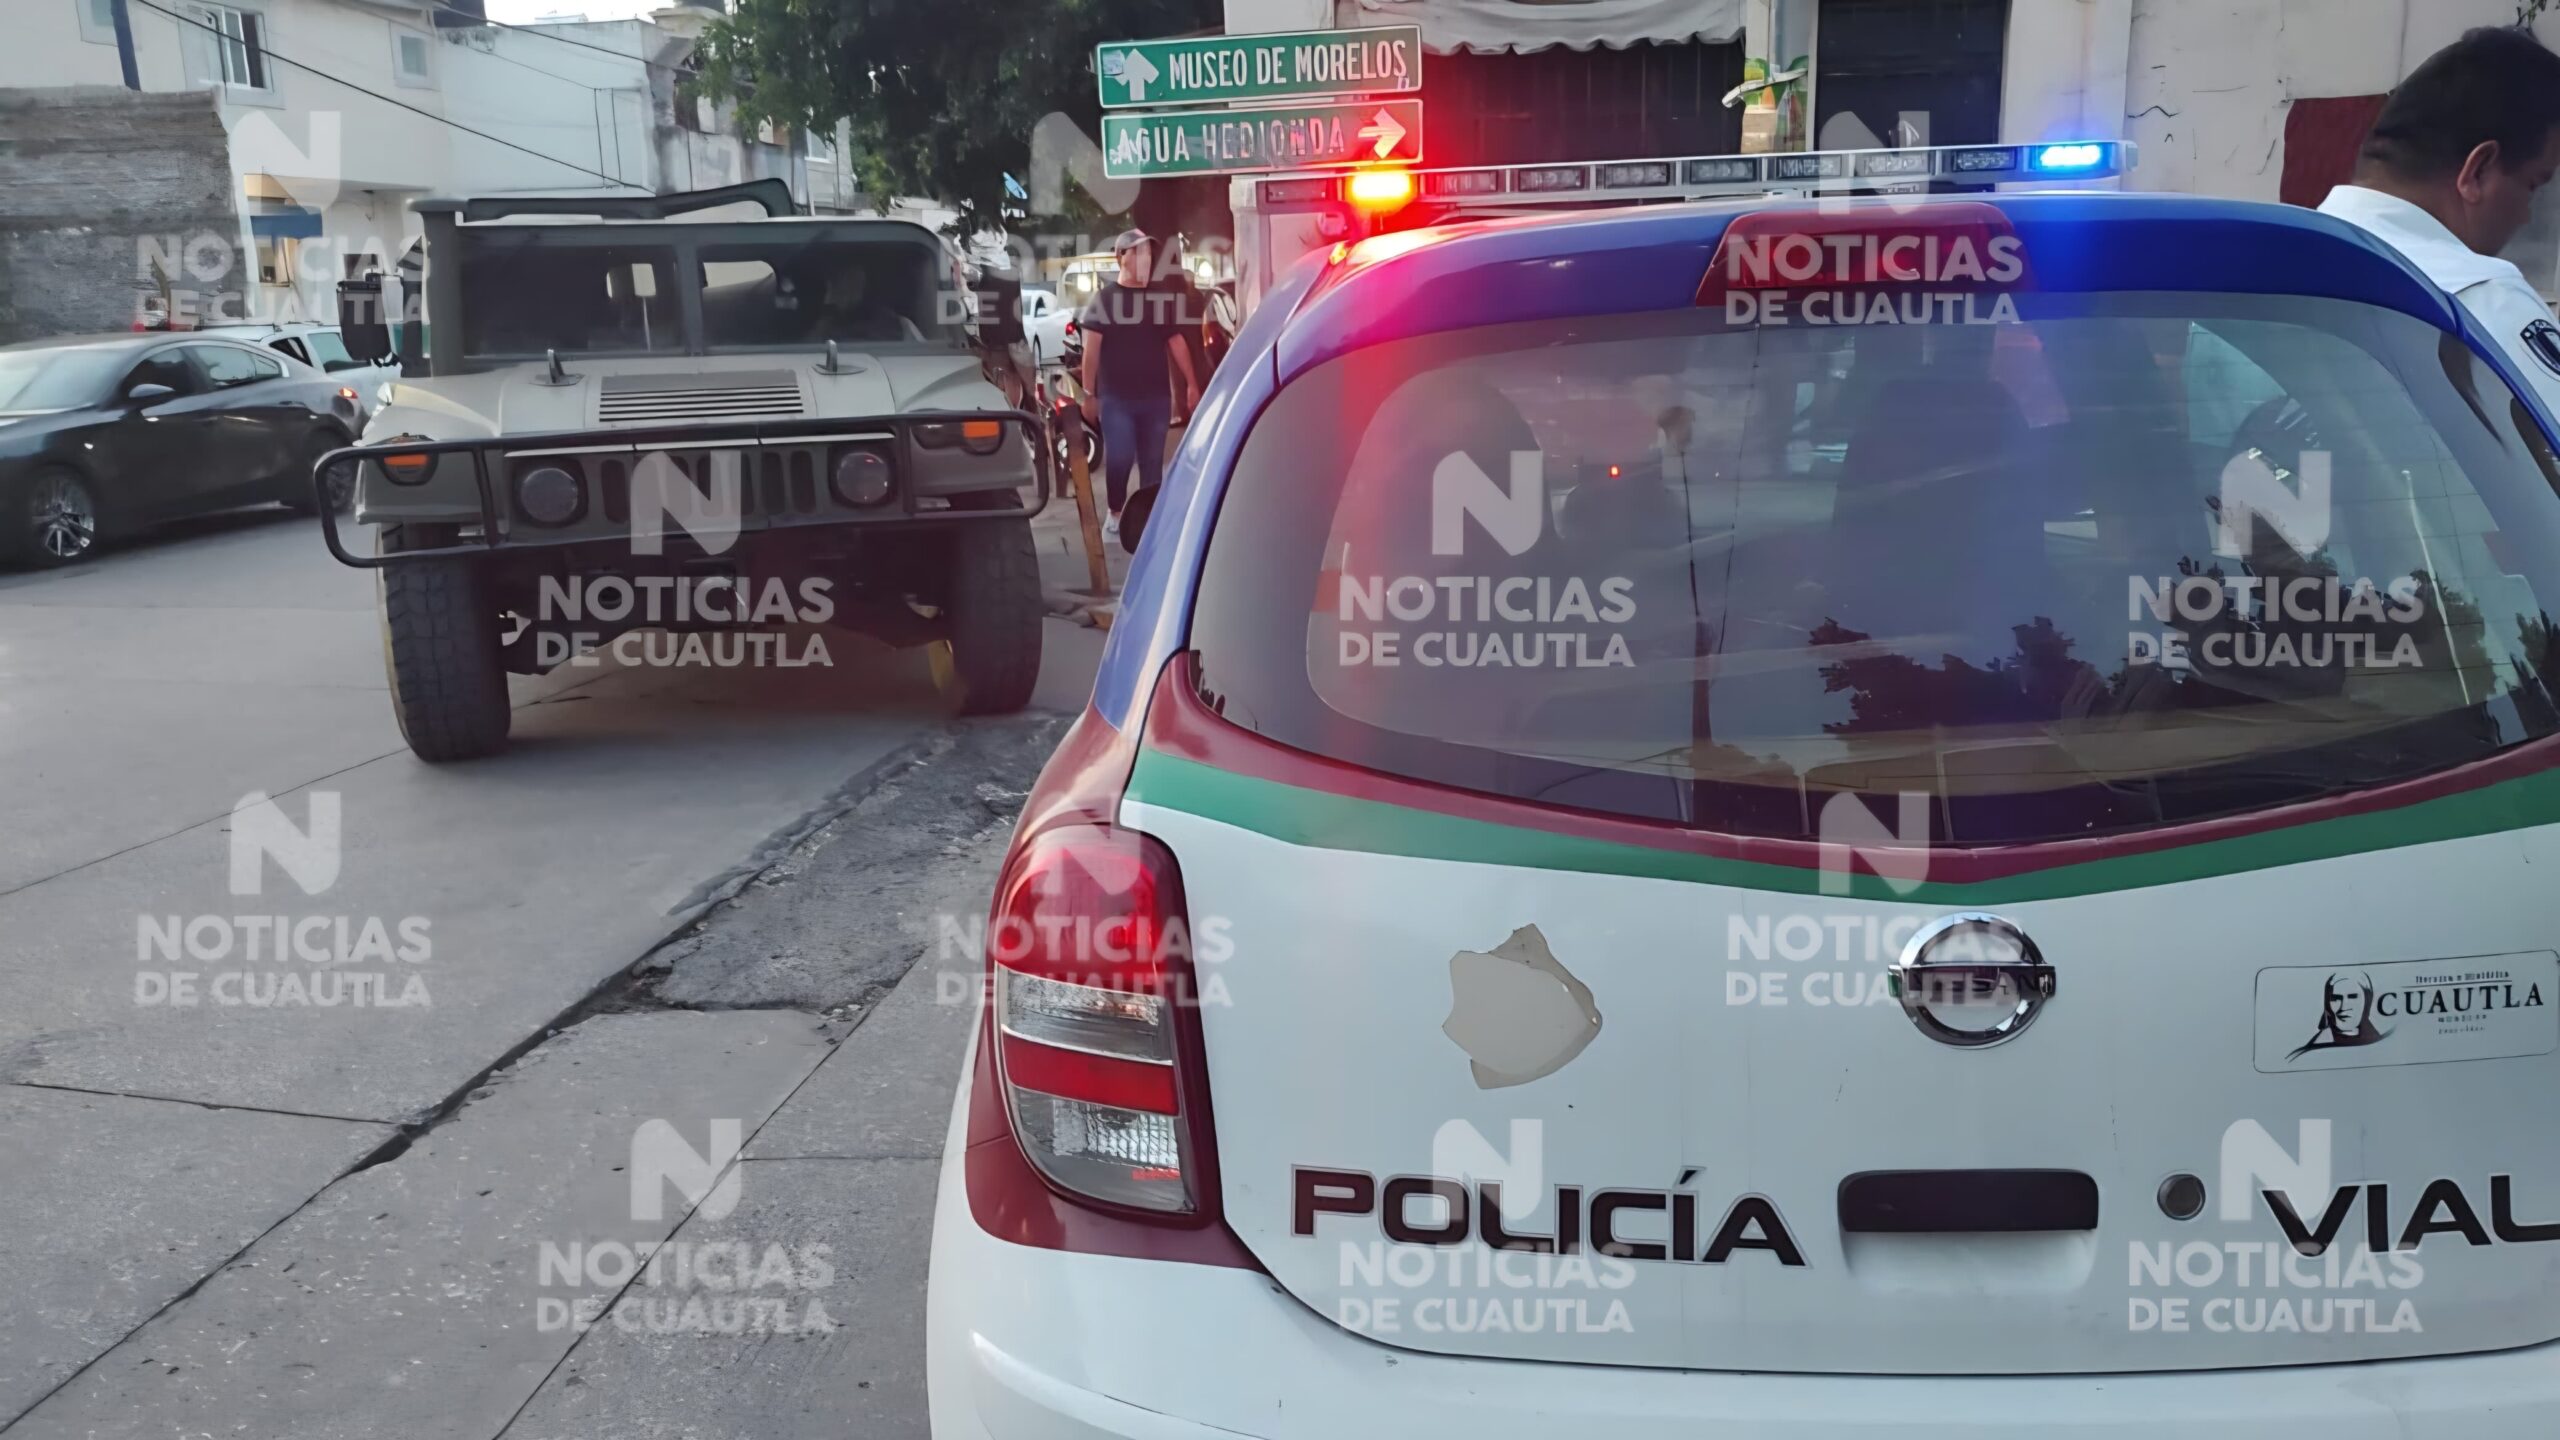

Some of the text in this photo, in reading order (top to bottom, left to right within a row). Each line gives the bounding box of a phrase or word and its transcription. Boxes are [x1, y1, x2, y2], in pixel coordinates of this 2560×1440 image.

[1168, 40, 1408, 90] MUSEO DE MORELOS
[1116, 116, 1345, 165] AGUA HEDIONDA
[2376, 981, 2545, 1017] CUAUTLA
[1292, 1164, 1811, 1268] POLICÍA
[2262, 1174, 2560, 1258] VIAL
